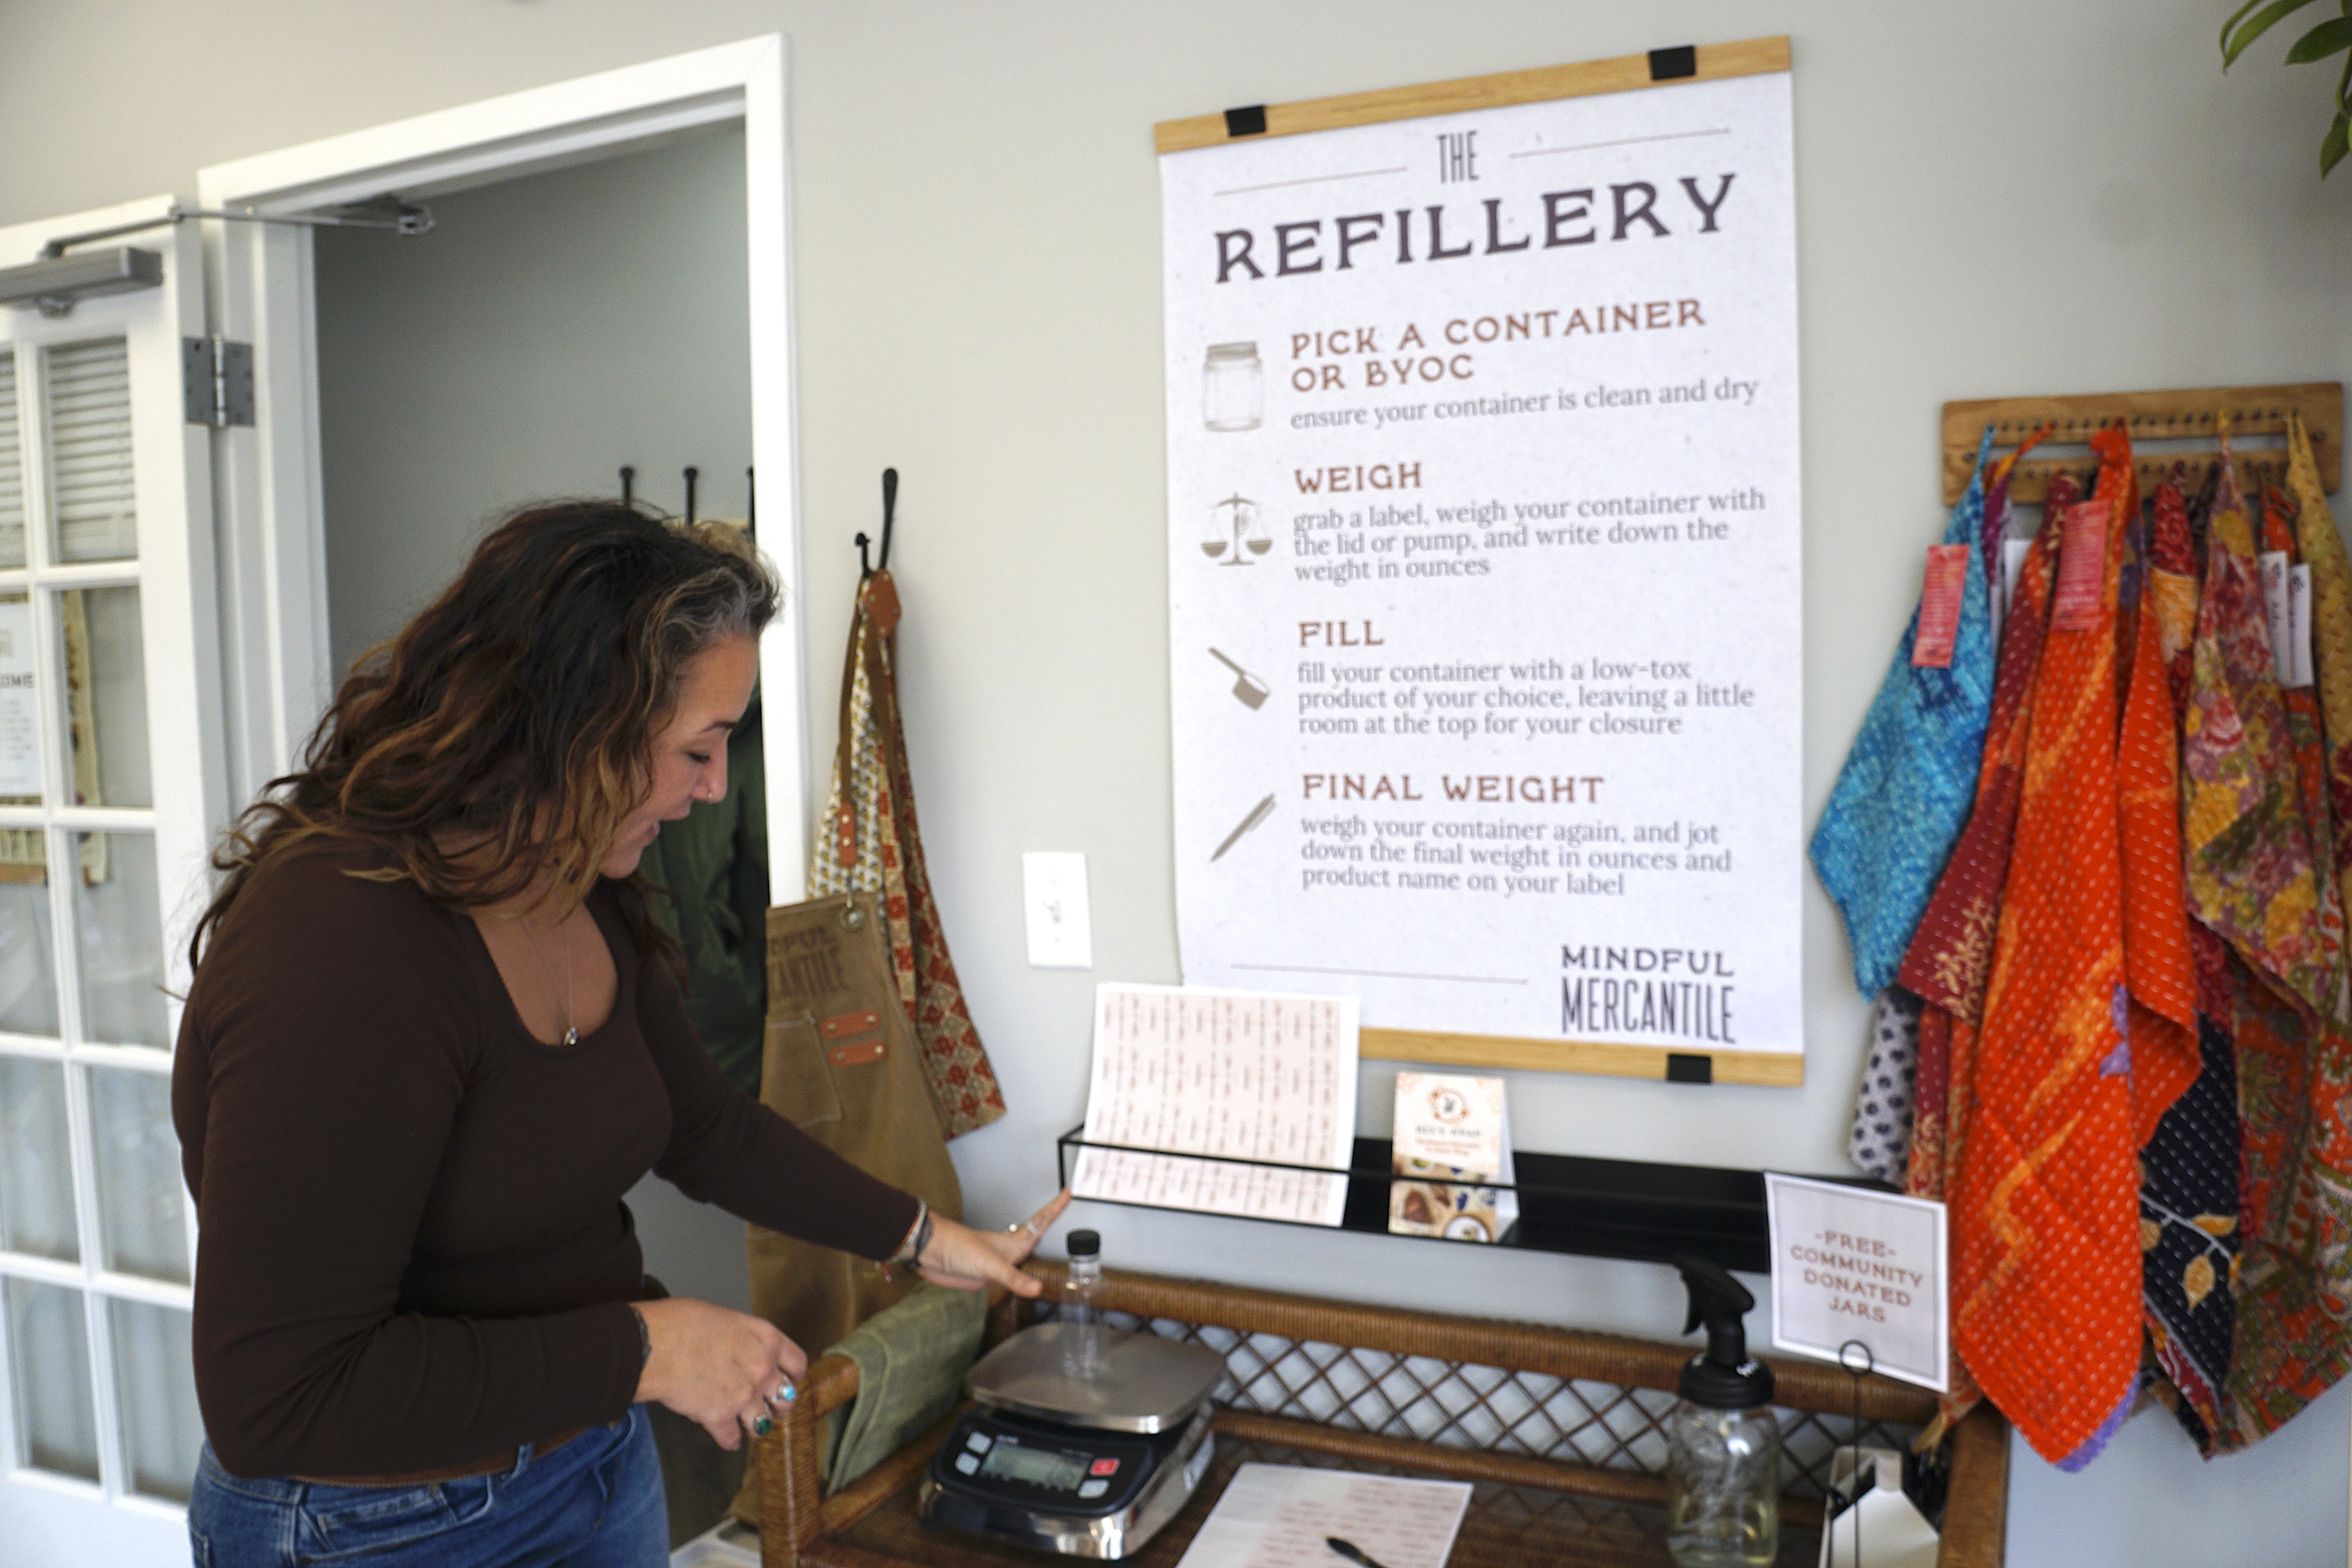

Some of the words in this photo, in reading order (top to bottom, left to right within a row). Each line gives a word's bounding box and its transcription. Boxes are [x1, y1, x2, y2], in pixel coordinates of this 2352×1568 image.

[1437, 131, 1479, 183] THE
[1215, 174, 1735, 283] REFILLERY
[1291, 326, 1379, 360] PICK
[1397, 322, 1426, 351] A
[1444, 298, 1706, 346] CONTAINER
[1291, 364, 1346, 393] OR
[1365, 353, 1474, 387] BYOC
[1290, 409, 1367, 428] ensure
[1374, 404, 1427, 429] your
[1434, 394, 1550, 418] container
[1558, 390, 1577, 410] is
[1584, 385, 1651, 408] clean
[1659, 378, 1706, 403] and
[1714, 377, 1758, 405] dry
[1294, 461, 1422, 494] WEIGH
[1294, 508, 1344, 537] grab
[1350, 513, 1362, 528] a
[1369, 503, 1429, 526] label,
[1436, 500, 1507, 528] weigh
[1514, 501, 1570, 523] your
[1577, 494, 1700, 517] container
[1708, 487, 1765, 510] with
[1294, 535, 1330, 556] the
[1337, 532, 1364, 554] lid
[1371, 536, 1396, 552] or
[1403, 534, 1477, 558] pump,
[1484, 525, 1528, 548] and
[1535, 524, 1600, 545] write
[1608, 521, 1678, 543] down
[1687, 518, 1729, 541] the
[1295, 559, 1370, 586] weight
[1378, 559, 1399, 578] in
[1406, 559, 1490, 577] ounces
[1298, 619, 1385, 648] FILL
[1298, 662, 1325, 683] fill
[1331, 667, 1383, 688] your
[1390, 664, 1503, 682] container
[1510, 658, 1564, 680] with
[1571, 664, 1584, 680] a
[1592, 658, 1691, 679] low-tox
[1298, 688, 1386, 714] product
[1394, 686, 1418, 708] of
[1423, 692, 1477, 713] your
[1484, 686, 1570, 708] choice,
[1579, 685, 1667, 713] leaving
[1674, 691, 1688, 706] a
[1697, 683, 1754, 706] little
[1299, 719, 1358, 733] room
[1365, 716, 1385, 734] at
[1394, 712, 1430, 734] the
[1438, 716, 1477, 740] top
[1485, 712, 1518, 733] for
[1526, 717, 1582, 740] your
[1589, 712, 1681, 734] closure
[1302, 773, 1423, 801] FINAL
[1441, 775, 1605, 804] WEIGHT
[1301, 815, 1367, 841] weigh
[1374, 821, 1425, 842] your
[1432, 820, 1546, 840] container
[1553, 824, 1626, 846] again,
[1633, 821, 1679, 842] and
[1686, 823, 1718, 850] jot
[1301, 840, 1363, 860] down
[1370, 840, 1406, 862] the
[1414, 842, 1463, 864] final
[1470, 844, 1549, 871] weight
[1559, 847, 1581, 867] in
[1588, 853, 1677, 869] ounces
[1685, 849, 1731, 871] and
[1303, 866, 1390, 890] product
[1398, 873, 1460, 889] name
[1467, 875, 1497, 891] on
[1504, 877, 1559, 897] your
[1567, 872, 1624, 895] label
[1561, 944, 1735, 978] MINDFUL
[1561, 976, 1736, 1045] MERCANTILE
[1790, 1244, 1922, 1288] COMMUNITY
[1804, 1269, 1910, 1306] DONATED
[1829, 1297, 1884, 1322] JARS
